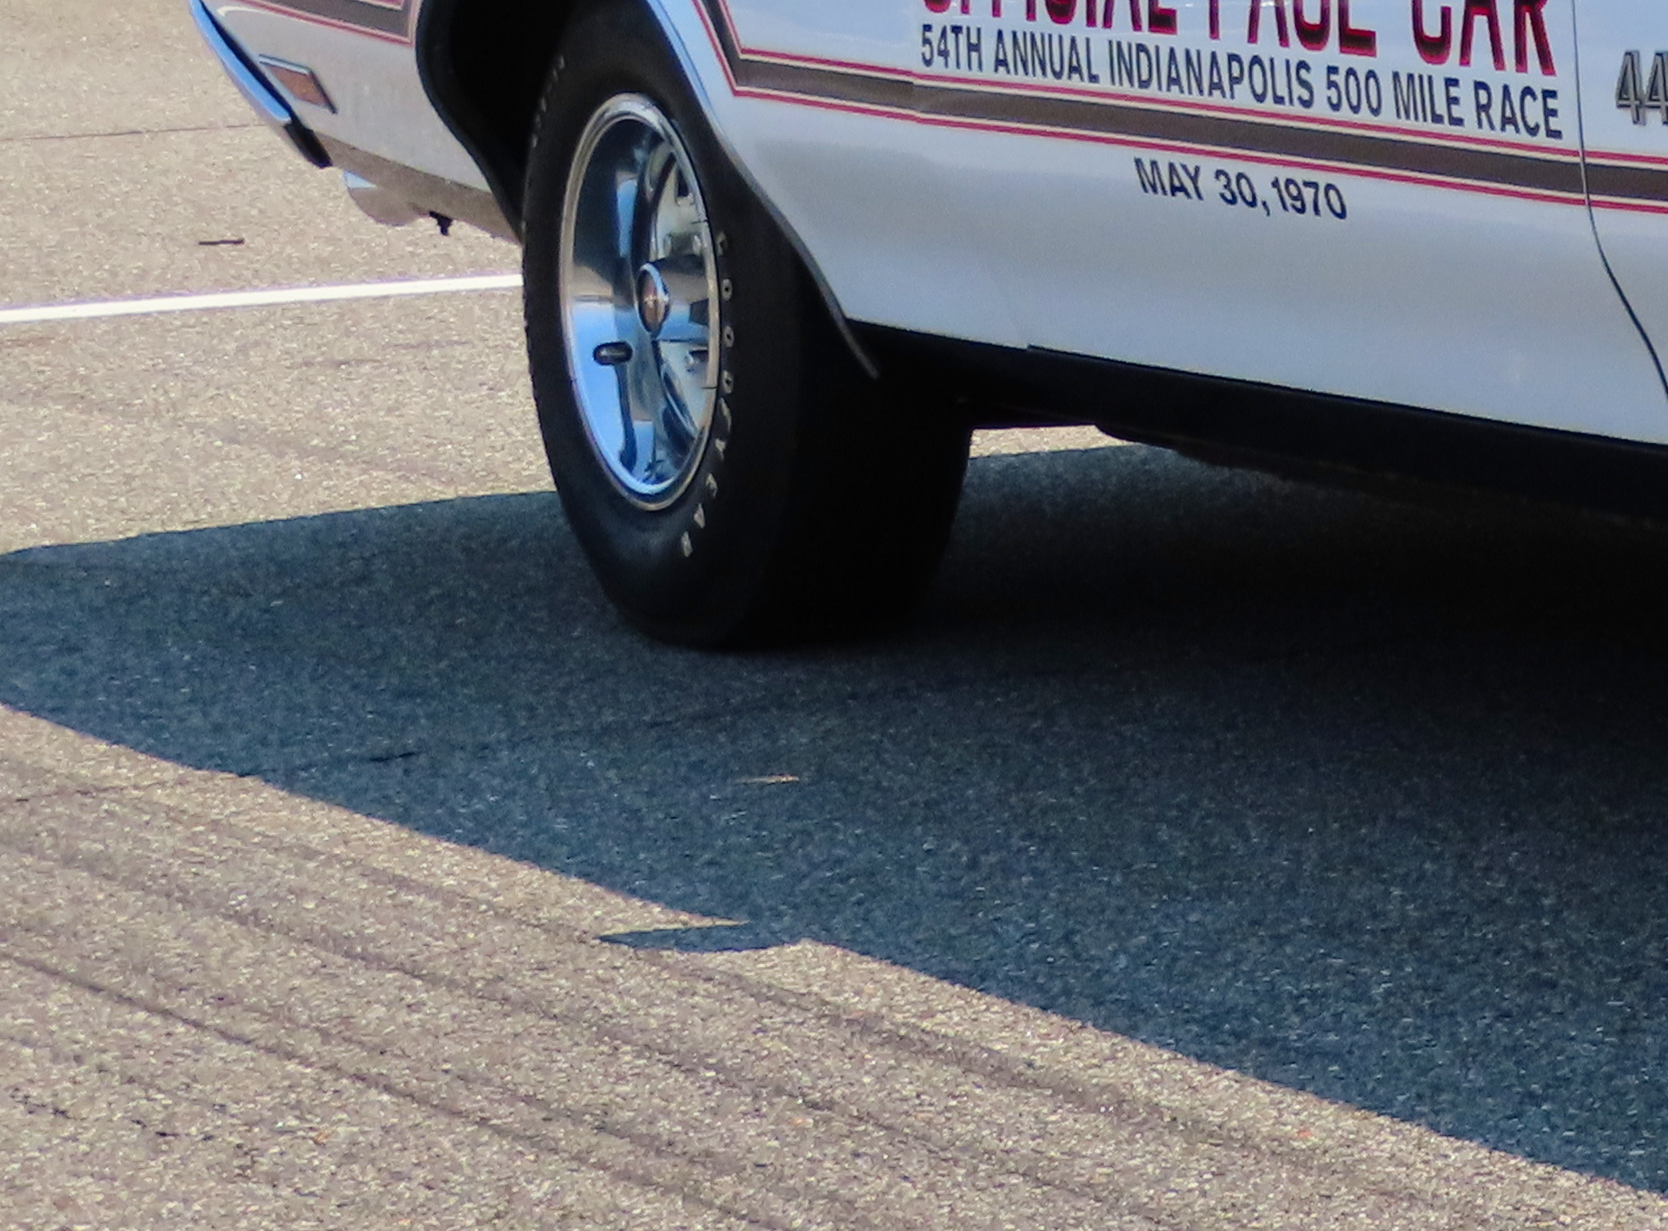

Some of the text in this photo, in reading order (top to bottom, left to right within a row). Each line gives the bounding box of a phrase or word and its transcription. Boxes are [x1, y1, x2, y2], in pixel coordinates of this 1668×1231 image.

[920, 23, 1563, 140] 54TH ANNUAL INDIANAPOLIS 500 MILE RACE
[1134, 157, 1204, 201] MAY
